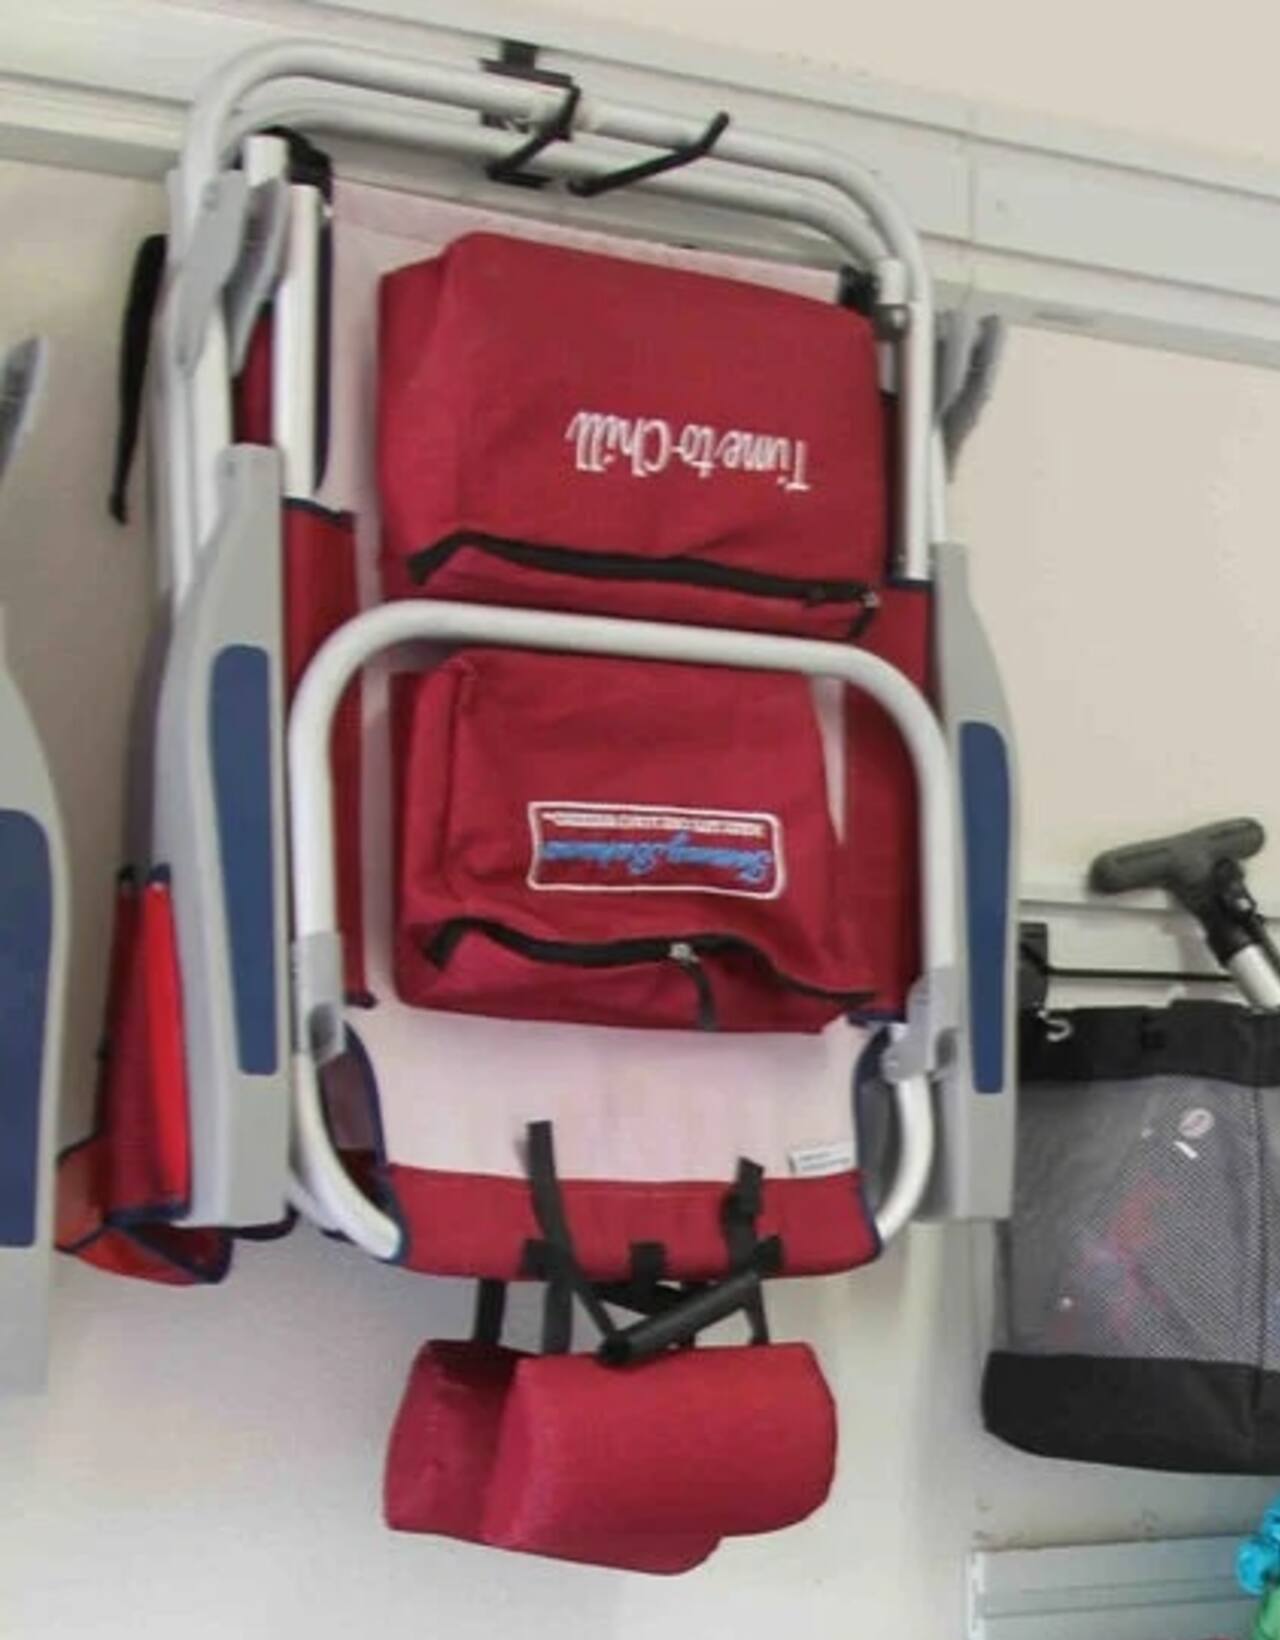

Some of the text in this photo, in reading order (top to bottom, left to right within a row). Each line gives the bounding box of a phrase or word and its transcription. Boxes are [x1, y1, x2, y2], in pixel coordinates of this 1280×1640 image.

[564, 411, 810, 491] Time to Chill
